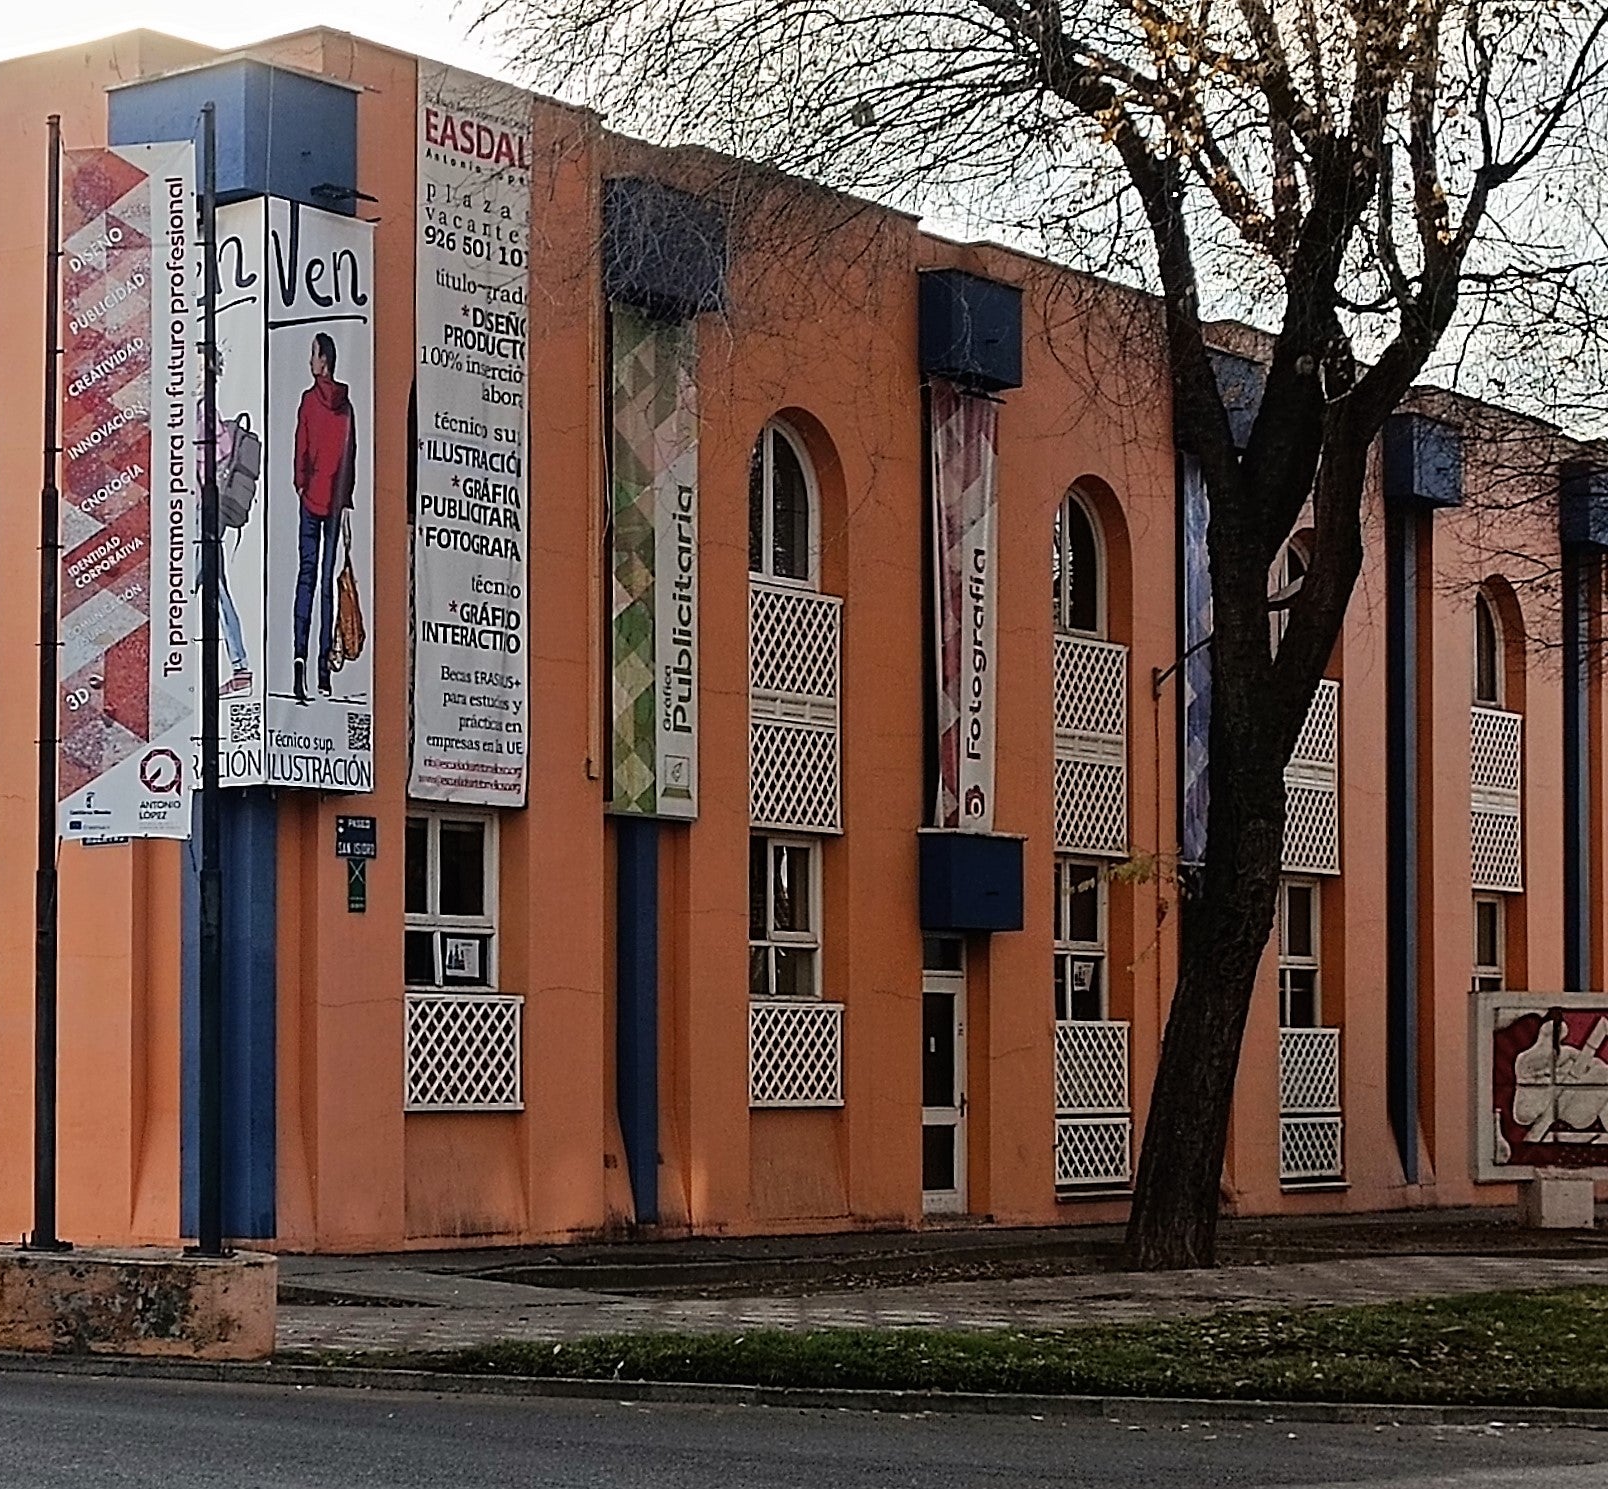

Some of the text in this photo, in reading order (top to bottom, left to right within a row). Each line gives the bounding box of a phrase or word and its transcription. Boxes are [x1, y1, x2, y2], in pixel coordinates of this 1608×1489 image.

[271, 202, 368, 306] Ven
[425, 225, 456, 251] 926
[462, 236, 491, 261] 501
[69, 273, 145, 335] PUBLICIDAD
[67, 337, 144, 397] CREATIVIDAD
[420, 346, 462, 371] 100%
[164, 177, 188, 677] Te preparamos para tu futuro profesional
[67, 536, 121, 577] IDENTIDAD
[75, 537, 144, 588] CORPORATIVA
[672, 485, 693, 734] Publicitaria
[65, 687, 90, 711] 3D
[267, 729, 336, 754] Técnico sup.
[505, 721, 522, 733] en
[506, 741, 523, 754] UE
[267, 754, 371, 787] ILUSTRACIÓN
